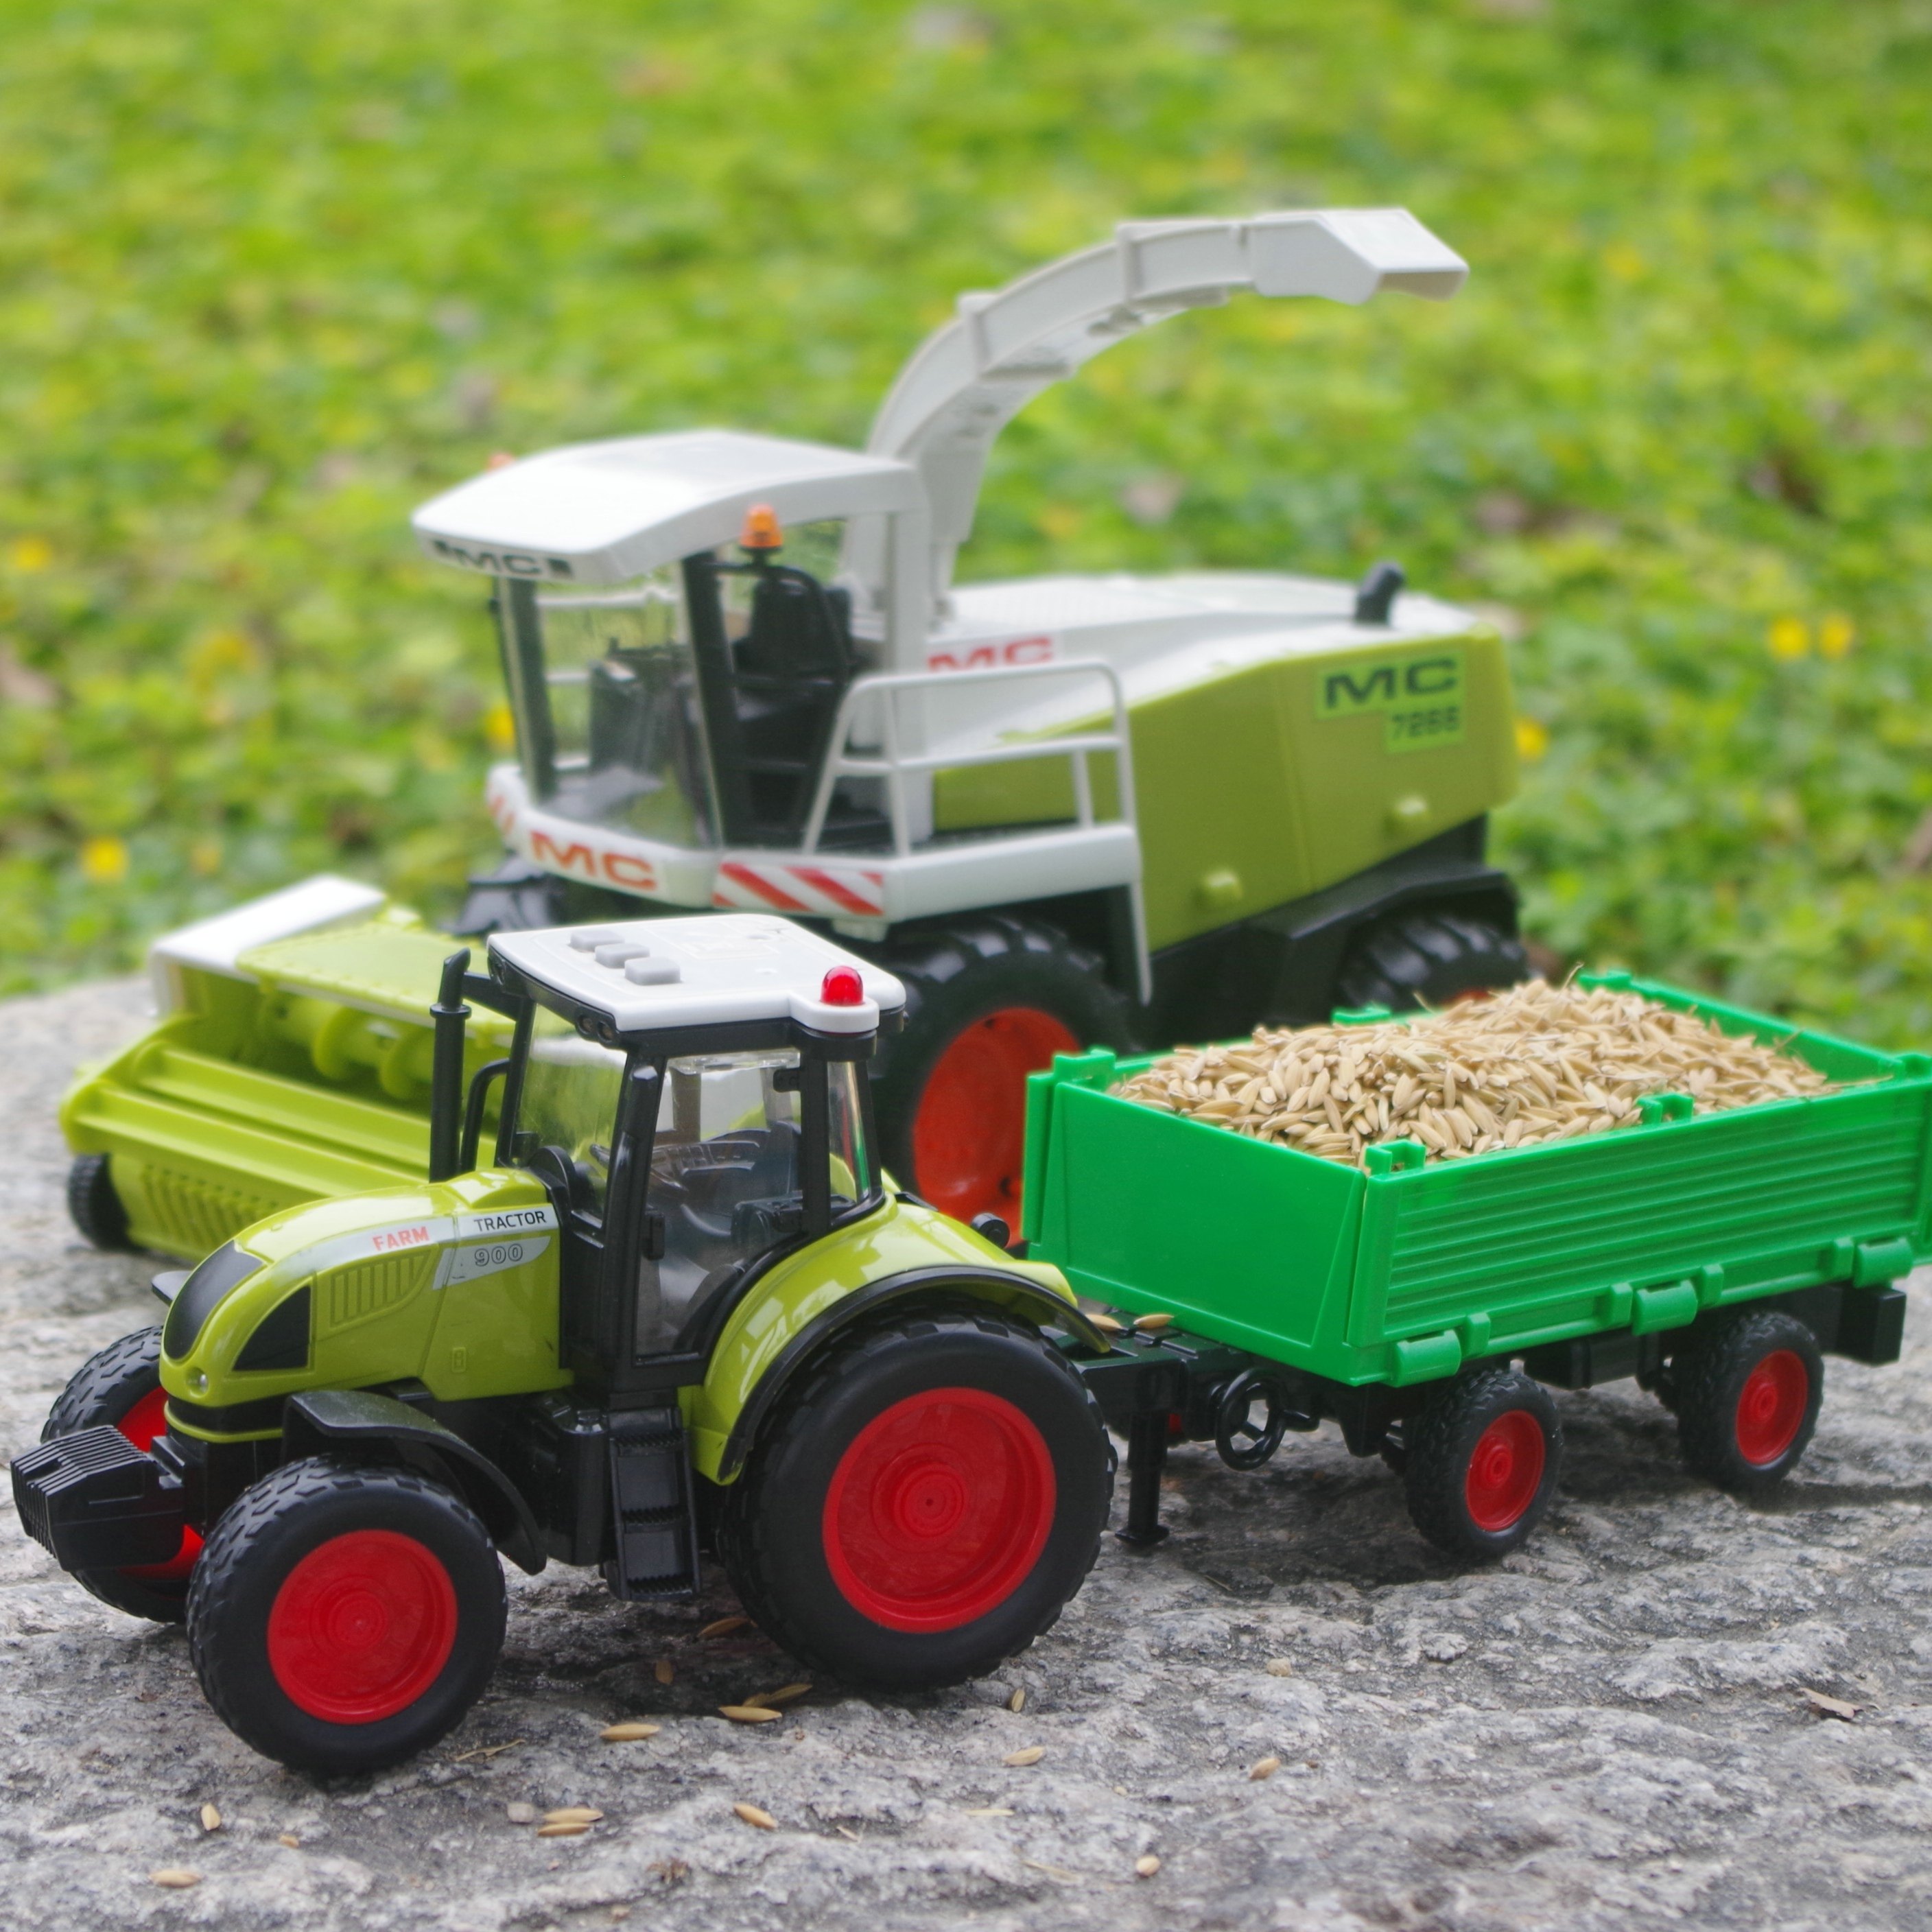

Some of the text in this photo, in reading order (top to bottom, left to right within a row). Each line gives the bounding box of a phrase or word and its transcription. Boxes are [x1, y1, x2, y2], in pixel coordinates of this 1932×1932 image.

[453, 547, 542, 575] MC
[927, 636, 1052, 674] MC
[1324, 659, 1457, 709] MC
[530, 829, 657, 890] MC
[373, 1211, 547, 1251] FARM TRACTOR
[475, 1244, 523, 1267] 900
